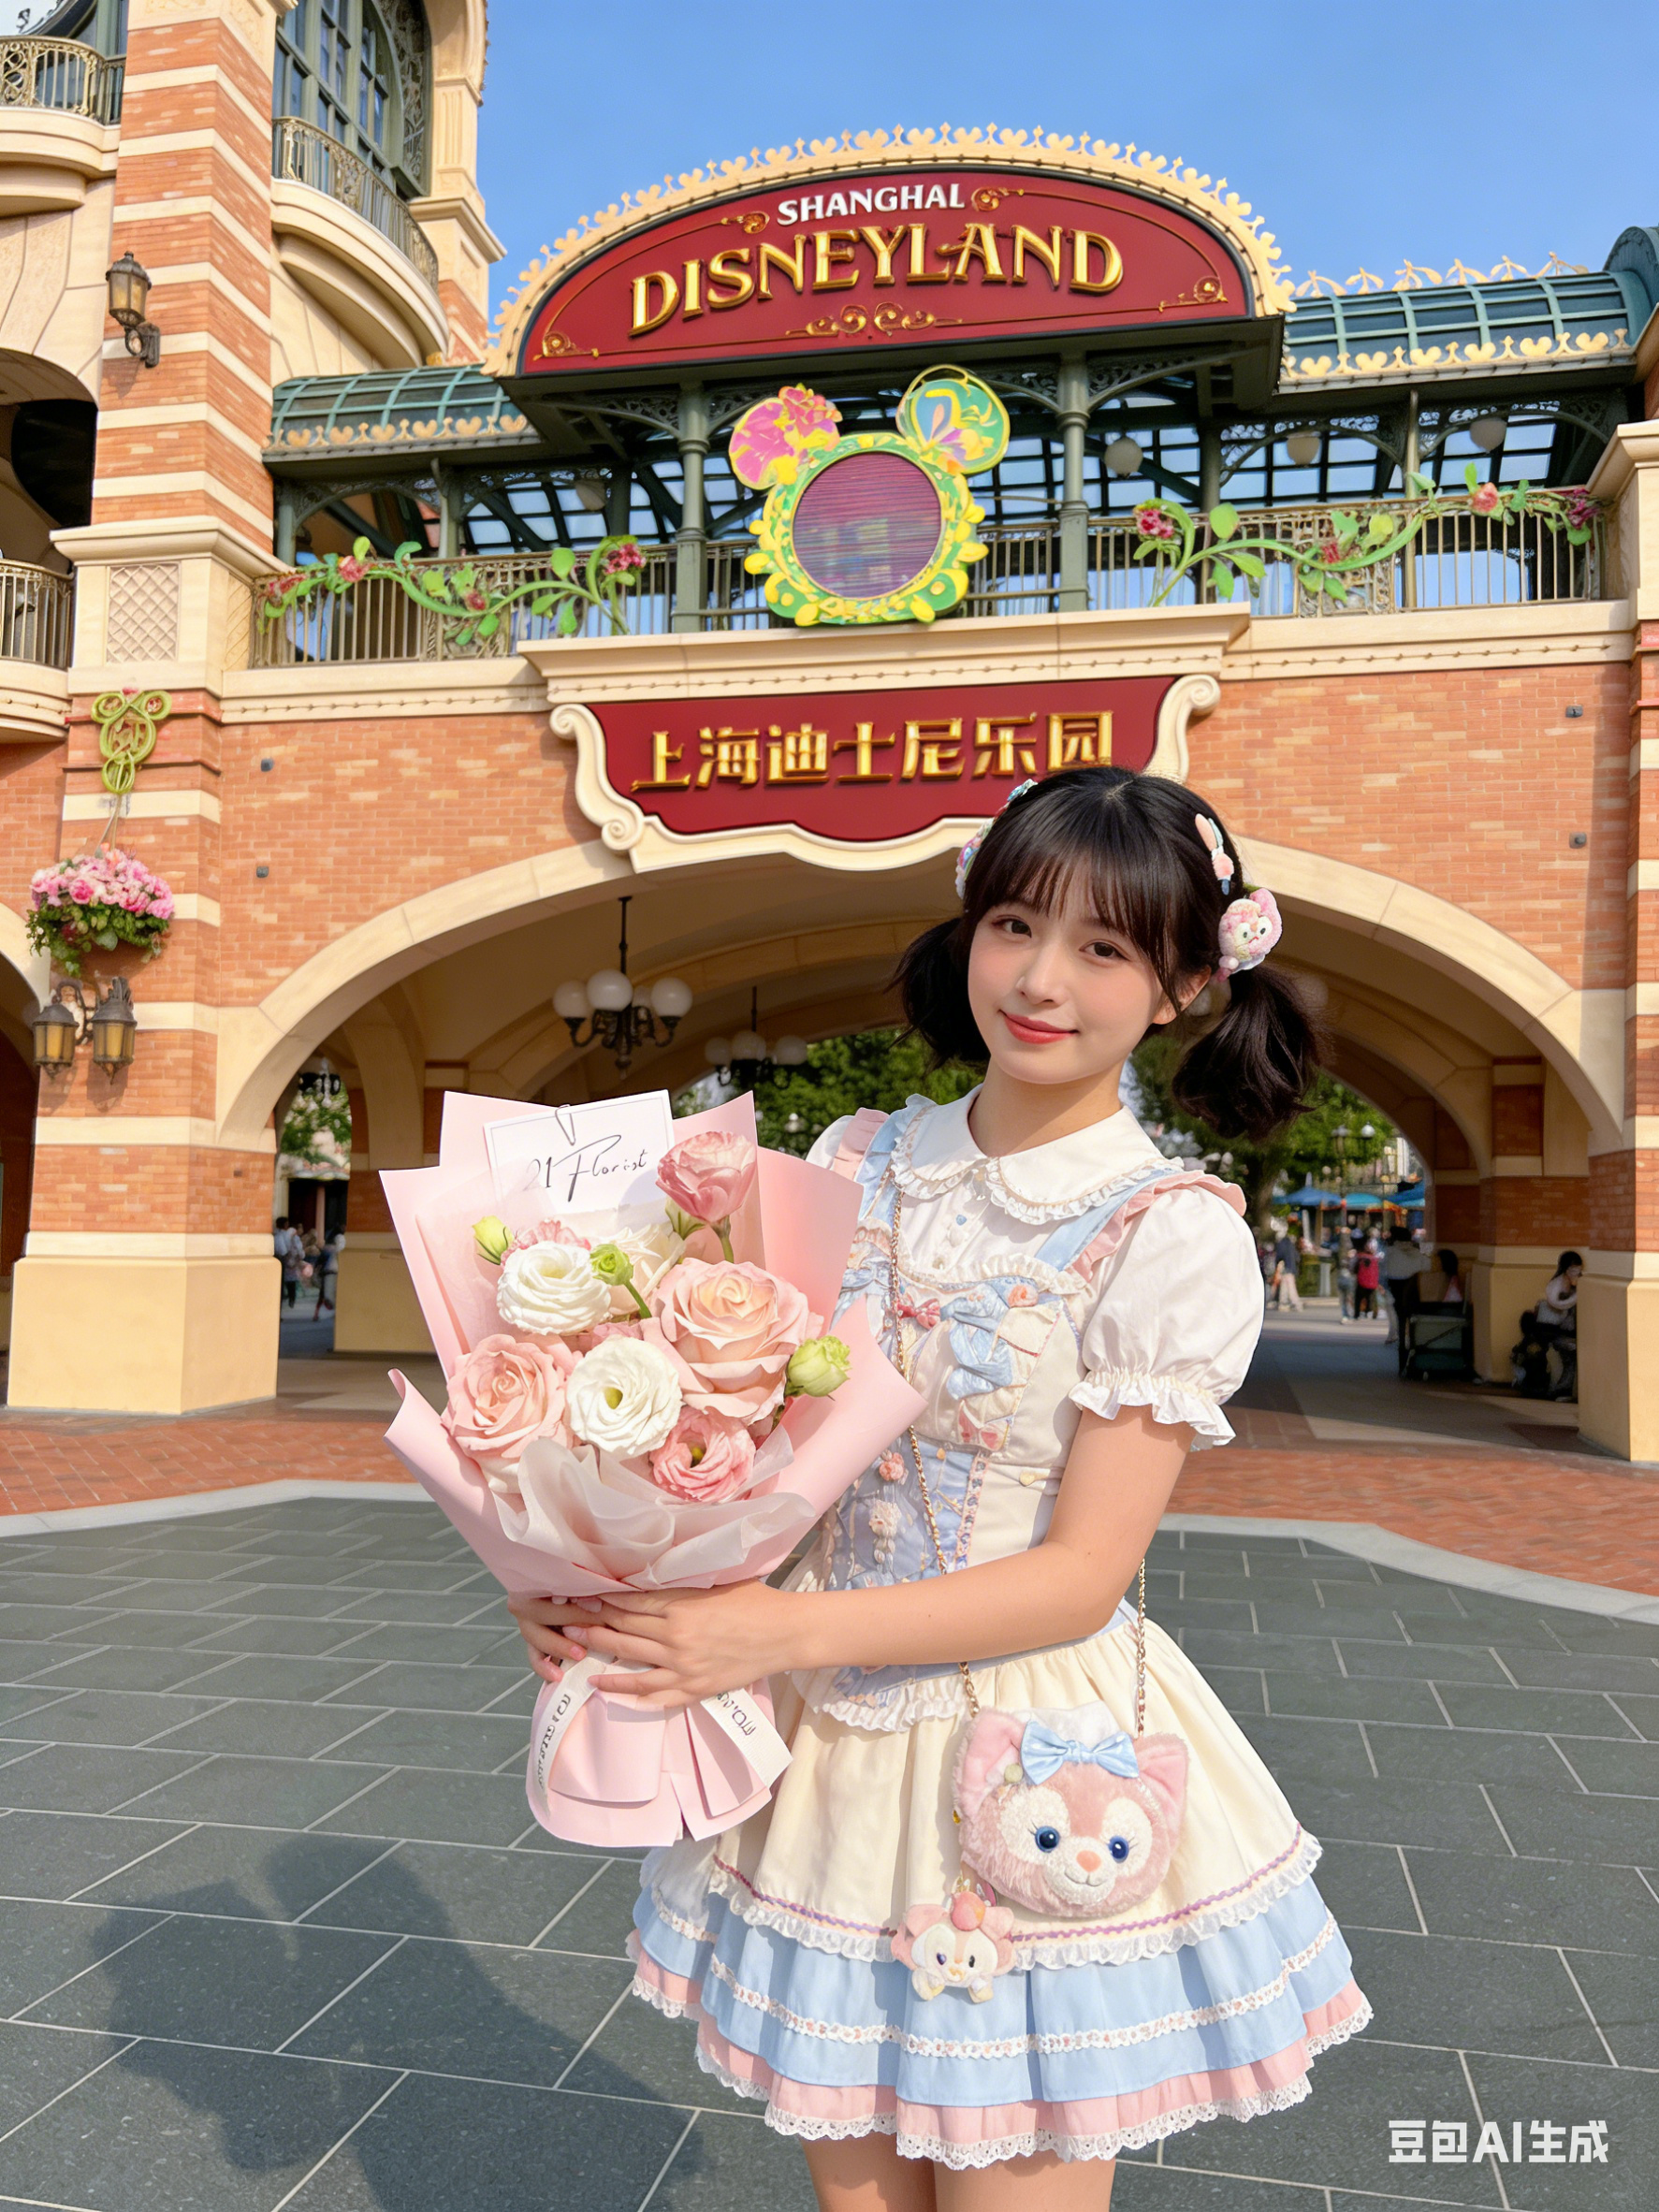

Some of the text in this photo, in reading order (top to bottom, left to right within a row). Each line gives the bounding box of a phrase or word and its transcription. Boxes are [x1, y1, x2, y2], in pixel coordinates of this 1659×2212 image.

[629, 223, 1124, 335] DISNEYLAND
[631, 711, 1113, 793] 上海迪士尼乐园
[554, 1134, 648, 1201] Florist
